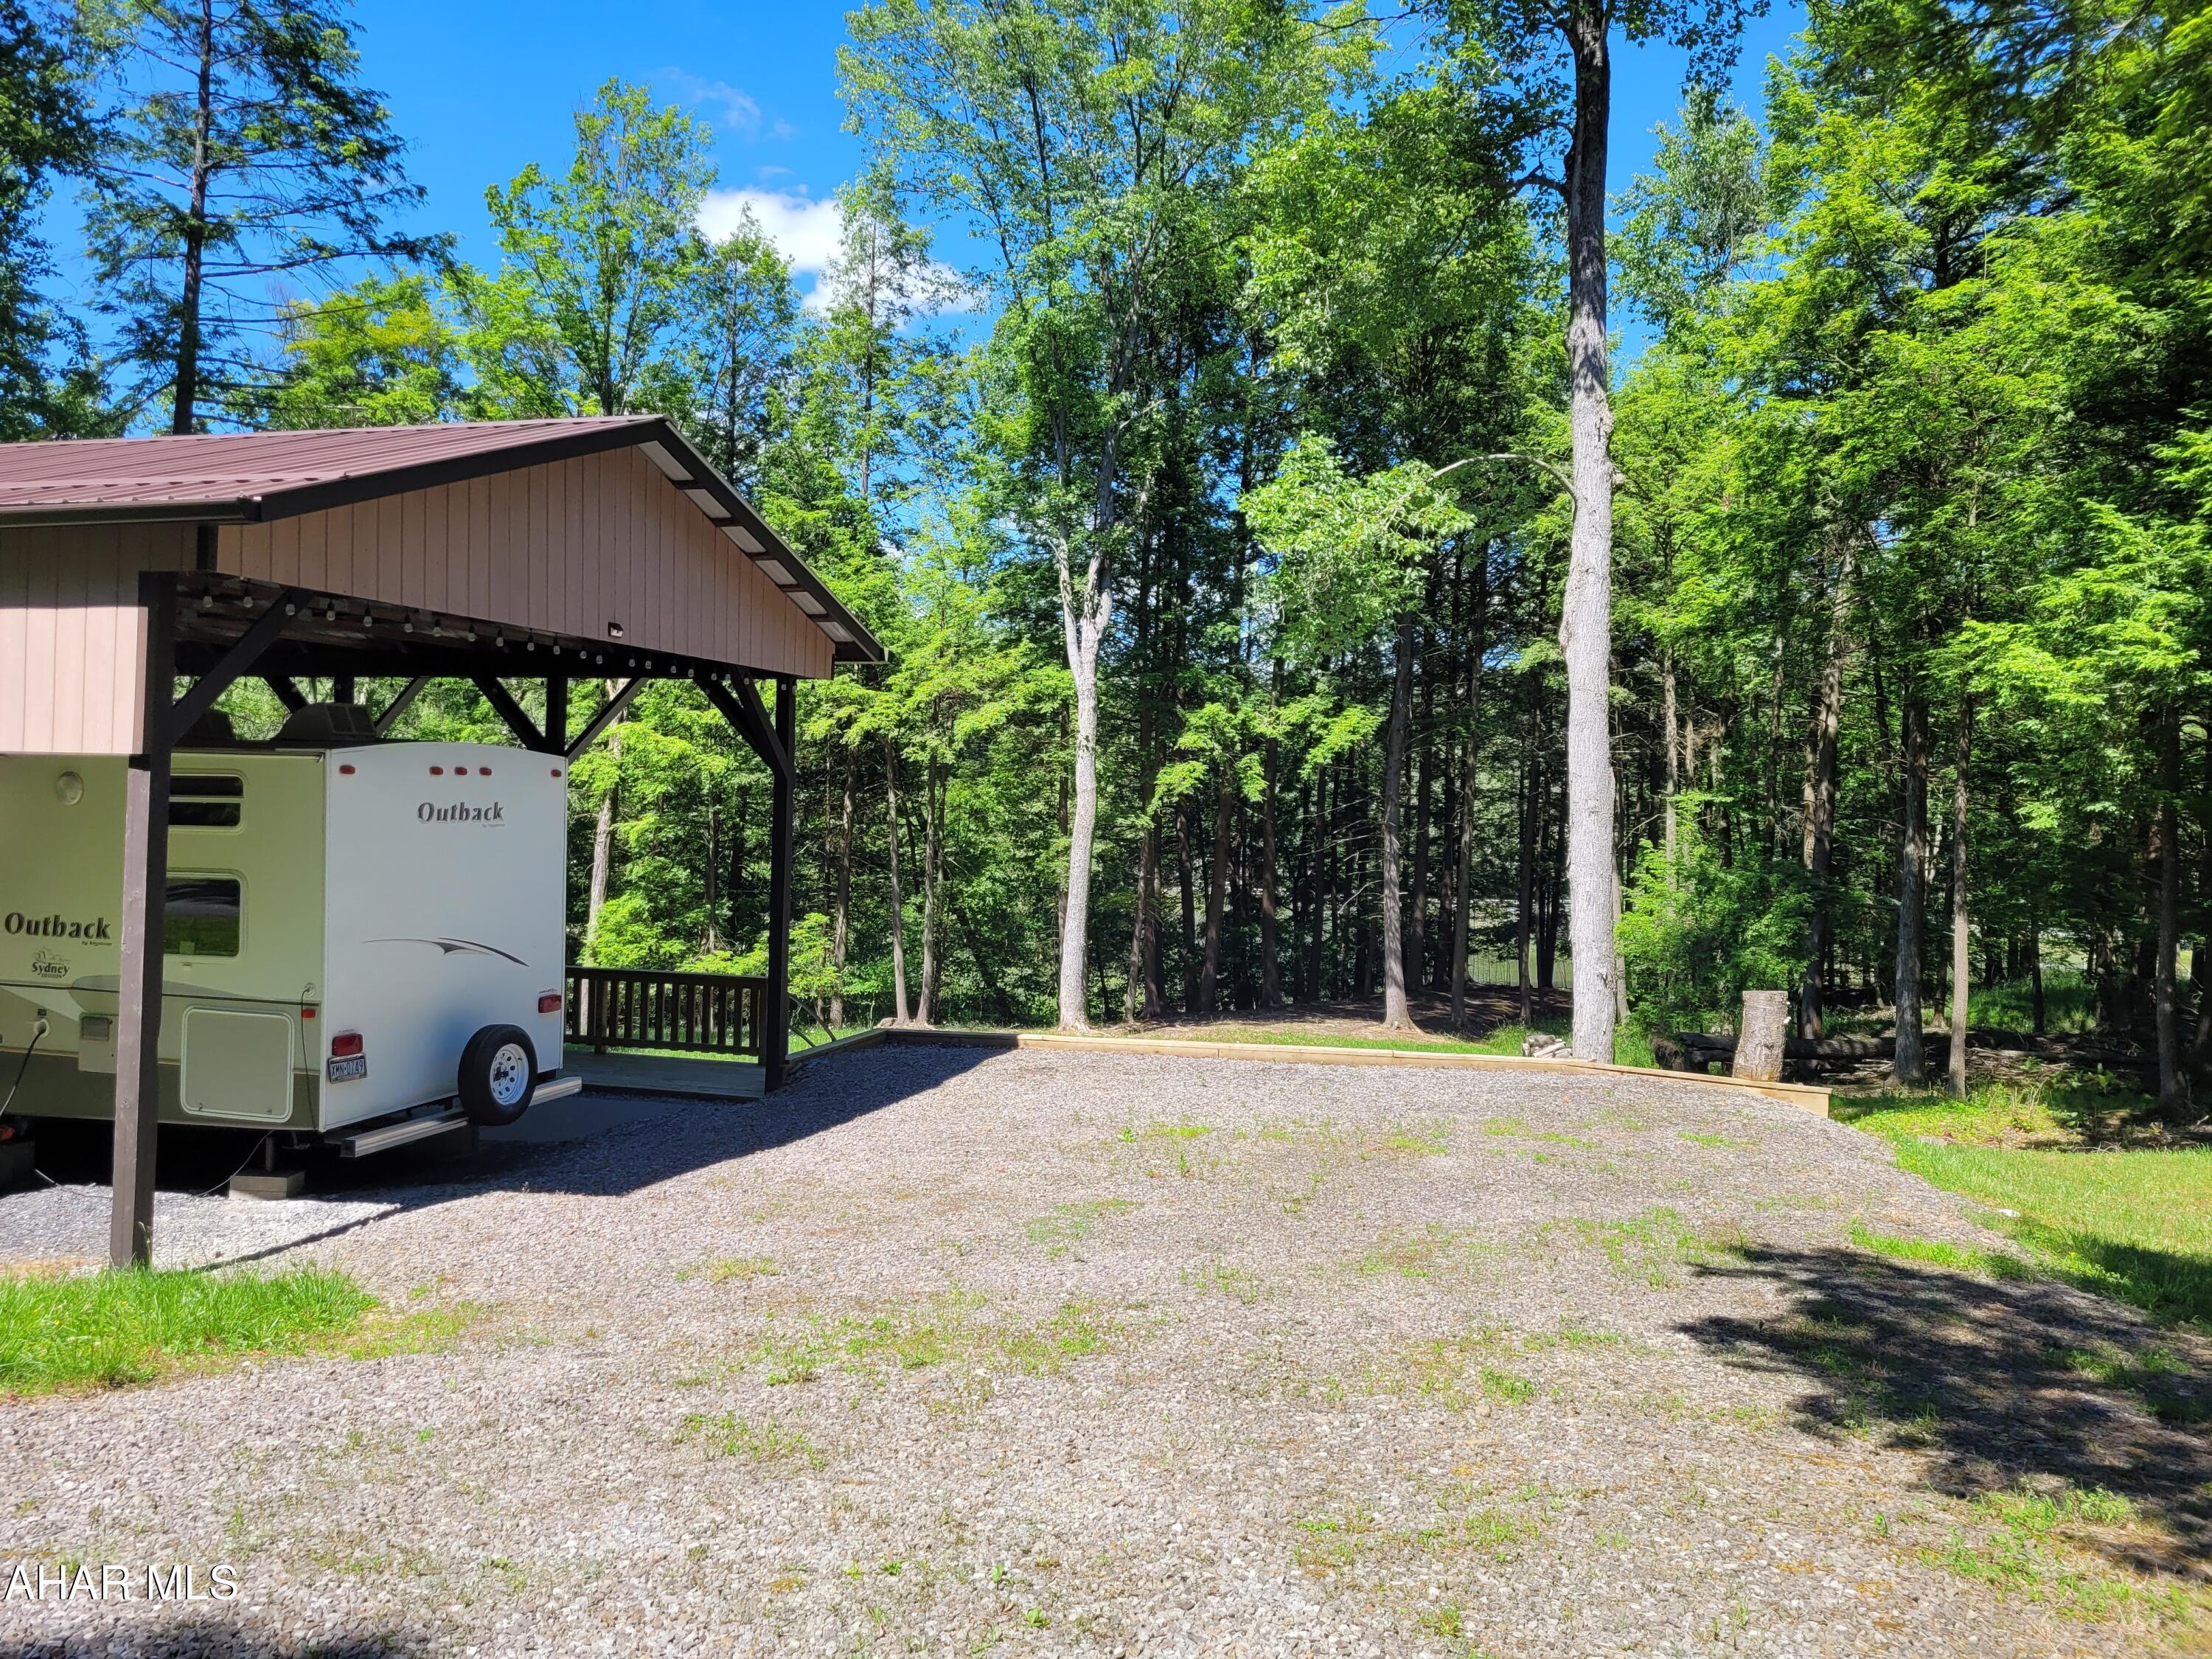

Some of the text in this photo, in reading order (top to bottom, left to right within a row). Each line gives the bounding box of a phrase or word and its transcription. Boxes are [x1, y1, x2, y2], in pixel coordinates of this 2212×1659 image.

[418, 801, 504, 821] Outback
[4, 912, 111, 939] Outback
[32, 961, 70, 977] Sydney
